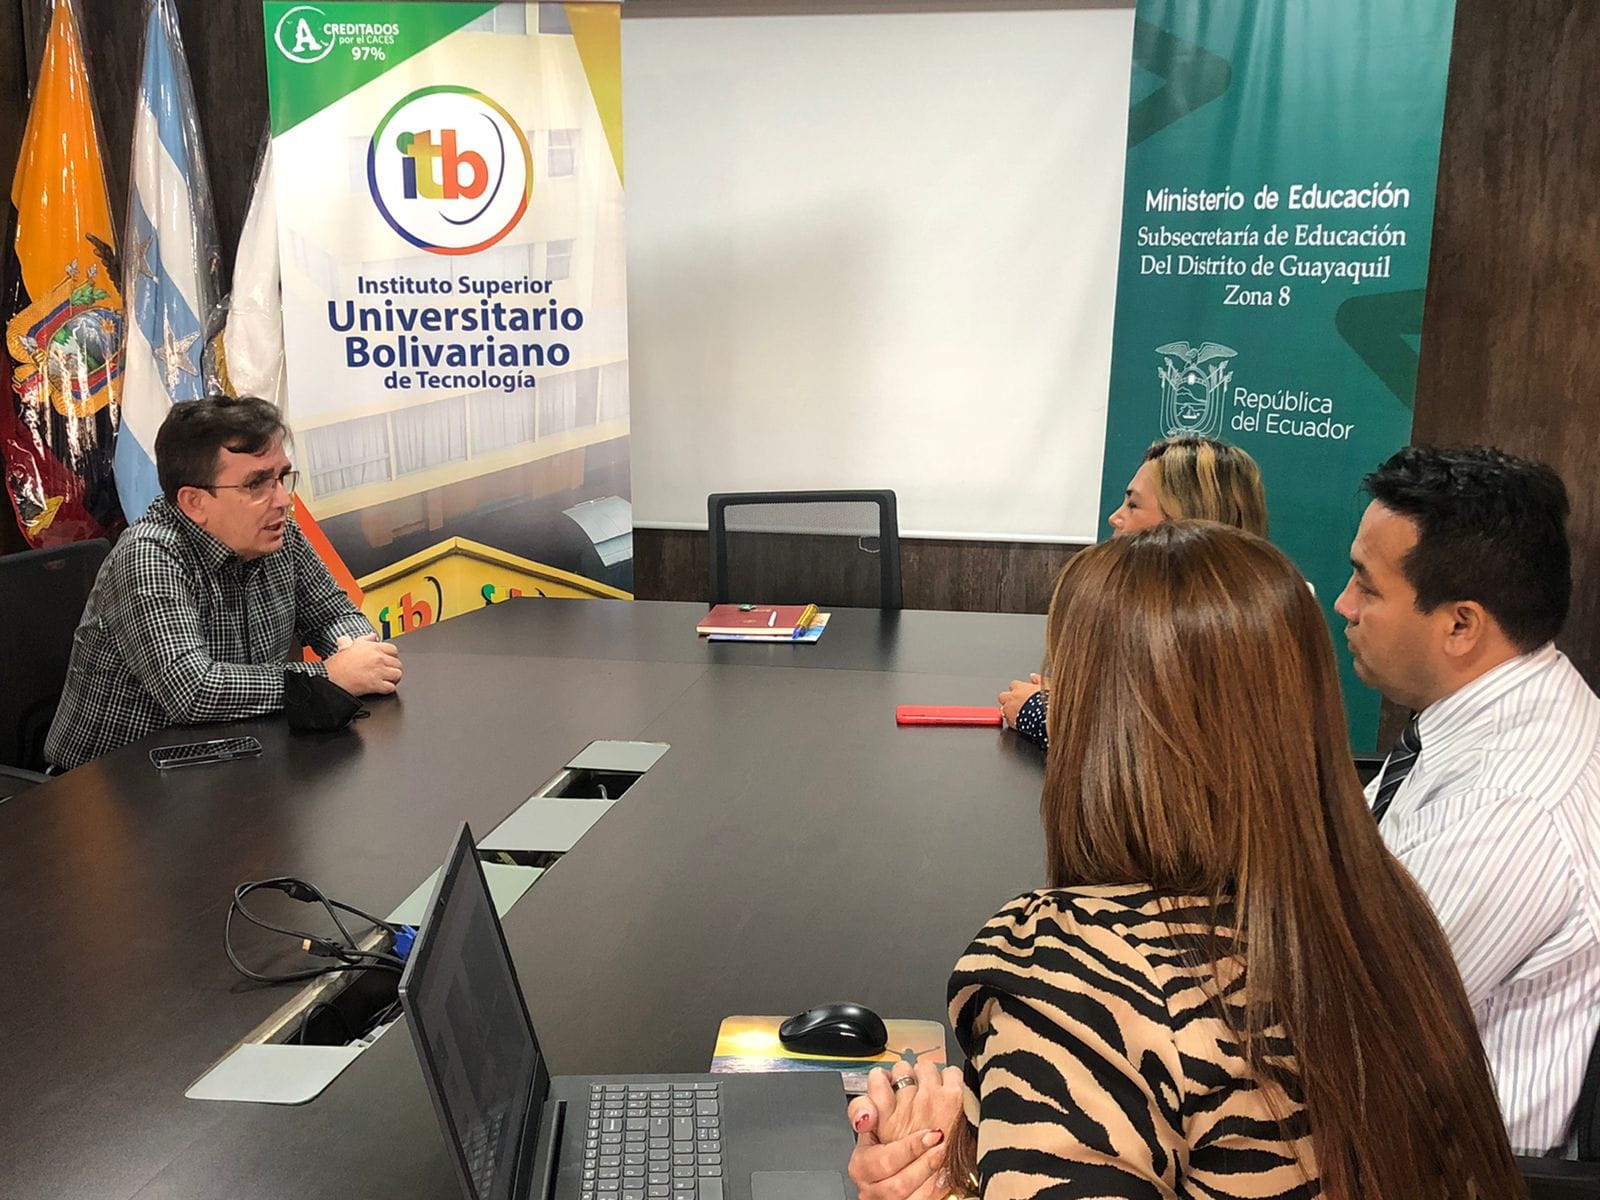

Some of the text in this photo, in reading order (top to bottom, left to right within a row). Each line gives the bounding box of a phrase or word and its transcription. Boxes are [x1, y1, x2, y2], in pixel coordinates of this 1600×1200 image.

[323, 23, 400, 35] CREDITADOS
[338, 34, 395, 45] por el CACES
[351, 46, 386, 61] 97%
[396, 129, 489, 200] itb
[1145, 181, 1411, 213] Ministerio de Educación
[1137, 223, 1407, 248] Subsecretaría de Educación
[1140, 255, 1391, 284] Del Distrito de Guayaquil
[357, 276, 553, 299] Instituto Superior
[1223, 285, 1291, 307] Zona 8
[327, 299, 585, 332] Universitario
[345, 335, 571, 368] Bolivariano
[383, 370, 537, 393] de Tecnología
[1233, 387, 1333, 414] República
[1231, 411, 1355, 440] del Ecuador
